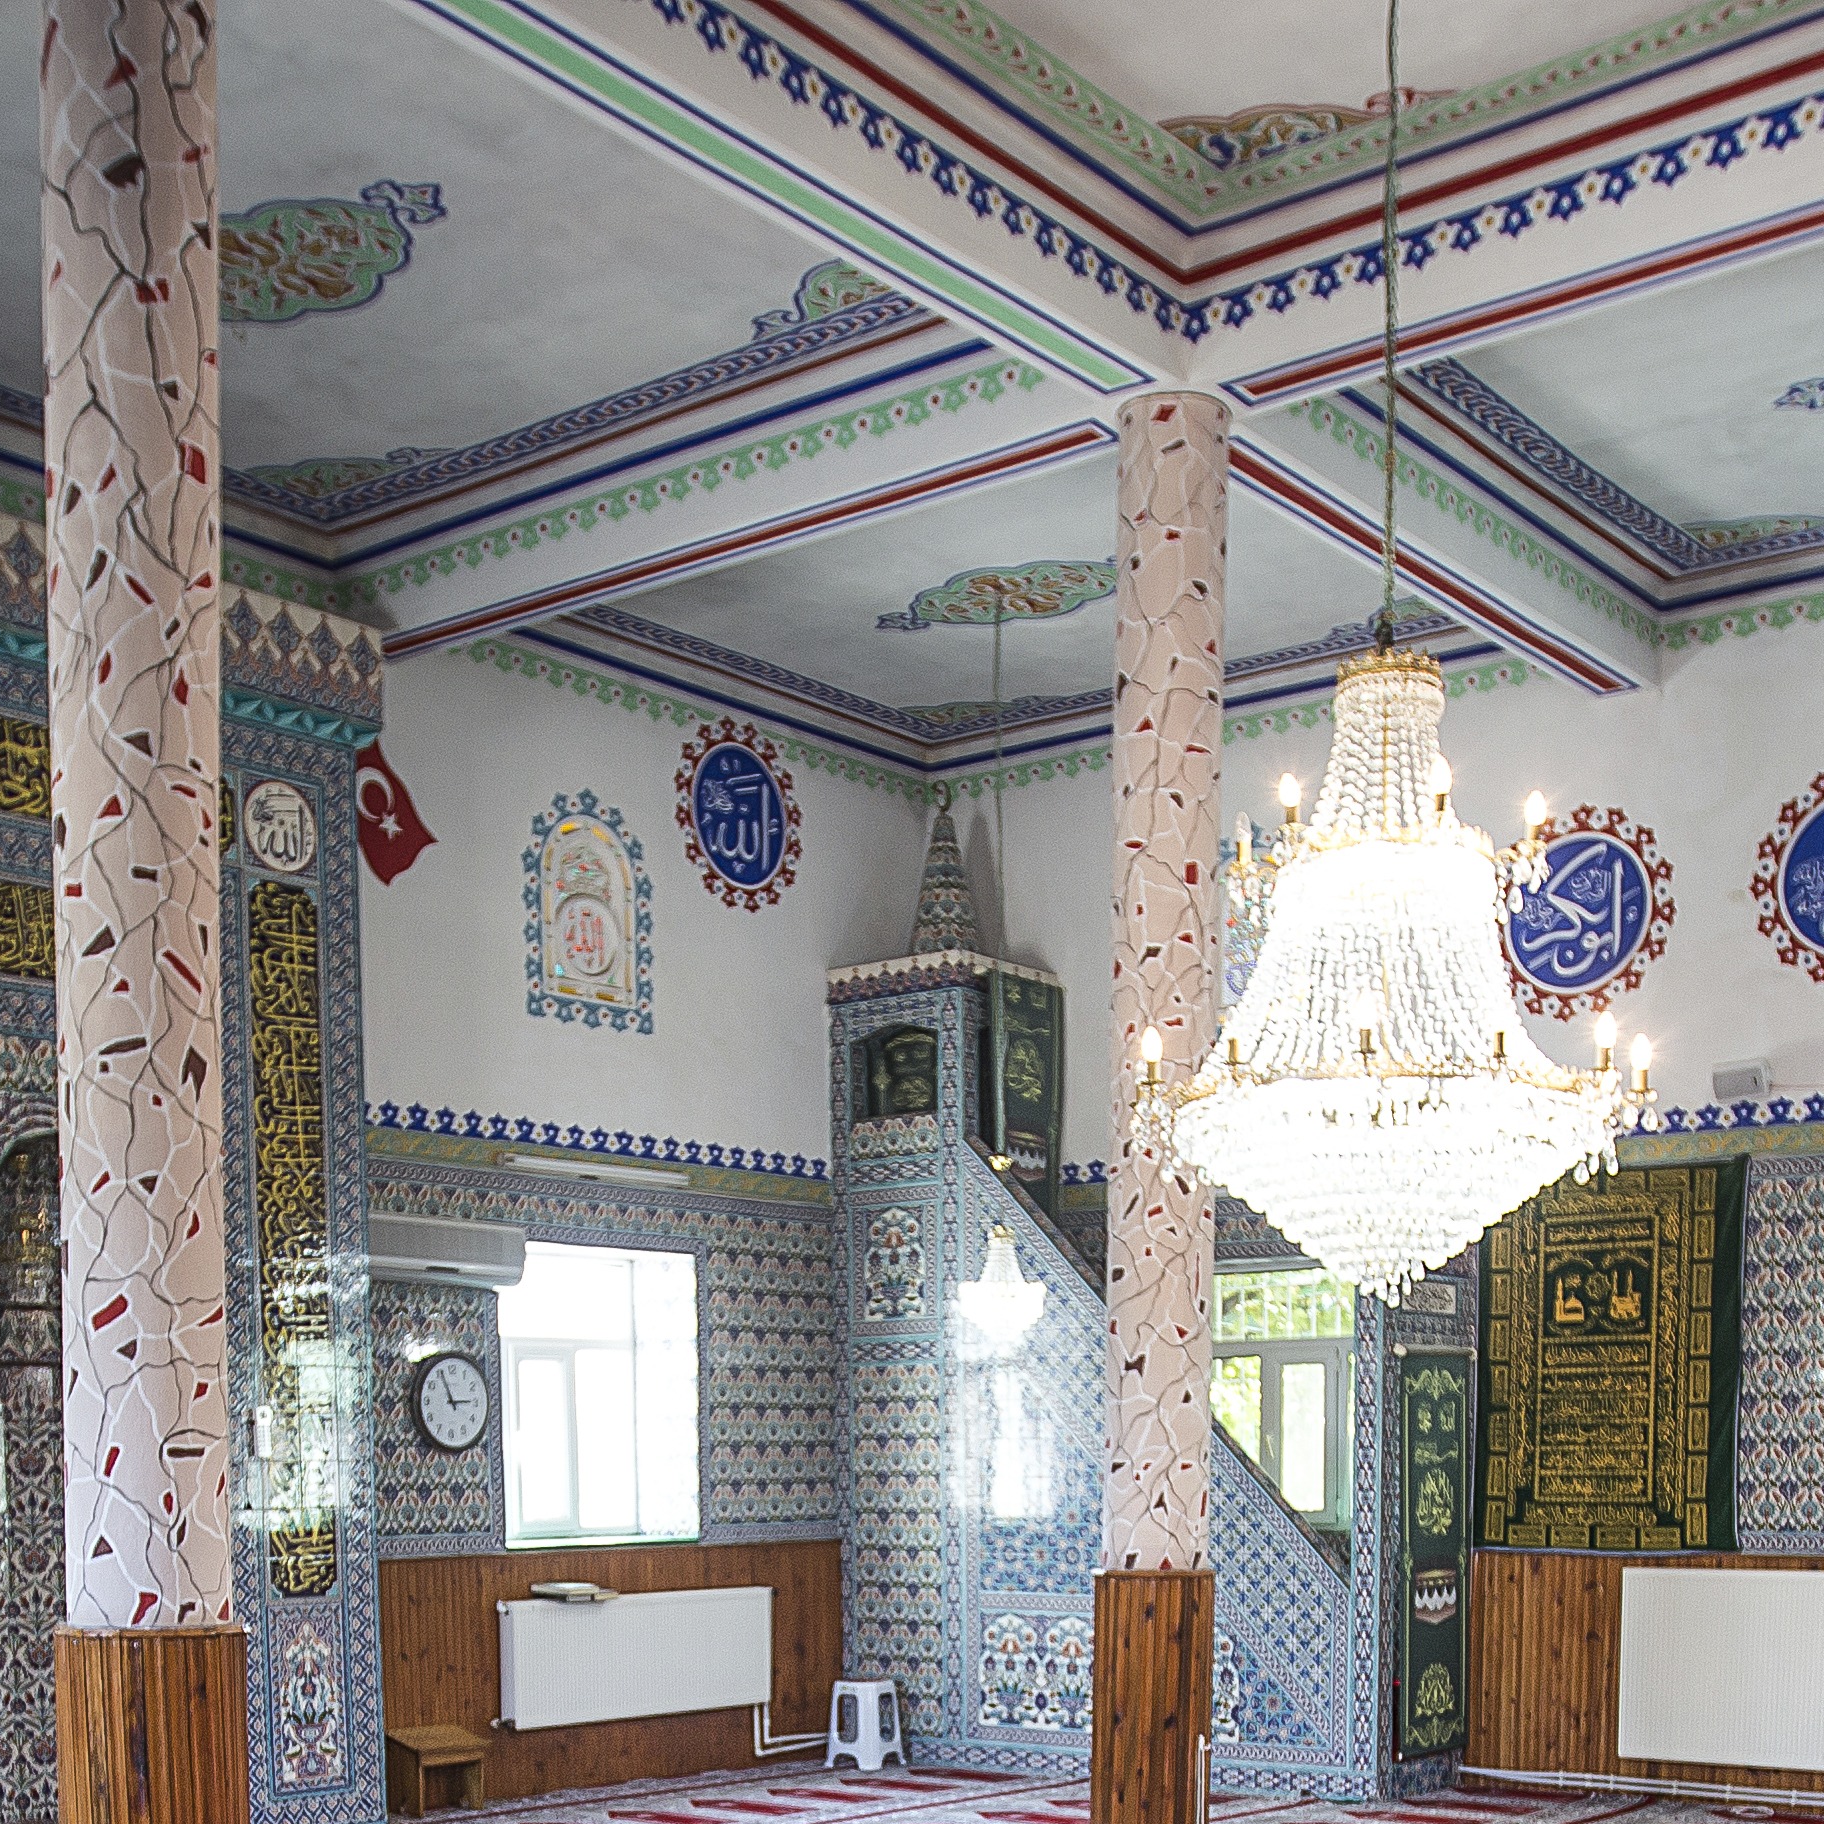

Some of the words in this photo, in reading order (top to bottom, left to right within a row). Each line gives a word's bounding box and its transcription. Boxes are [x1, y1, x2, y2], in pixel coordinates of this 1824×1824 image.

[704, 781, 772, 872] الله
[257, 803, 304, 863] الله
[448, 1364, 457, 1375] 12
[462, 1369, 468, 1380] 1
[427, 1380, 436, 1392] 10
[469, 1380, 477, 1392] 2
[423, 1396, 430, 1406] 9
[469, 1413, 477, 1423] 4
[436, 1423, 442, 1435] 7
[448, 1428, 455, 1439] 6
[460, 1424, 467, 1435] 5
